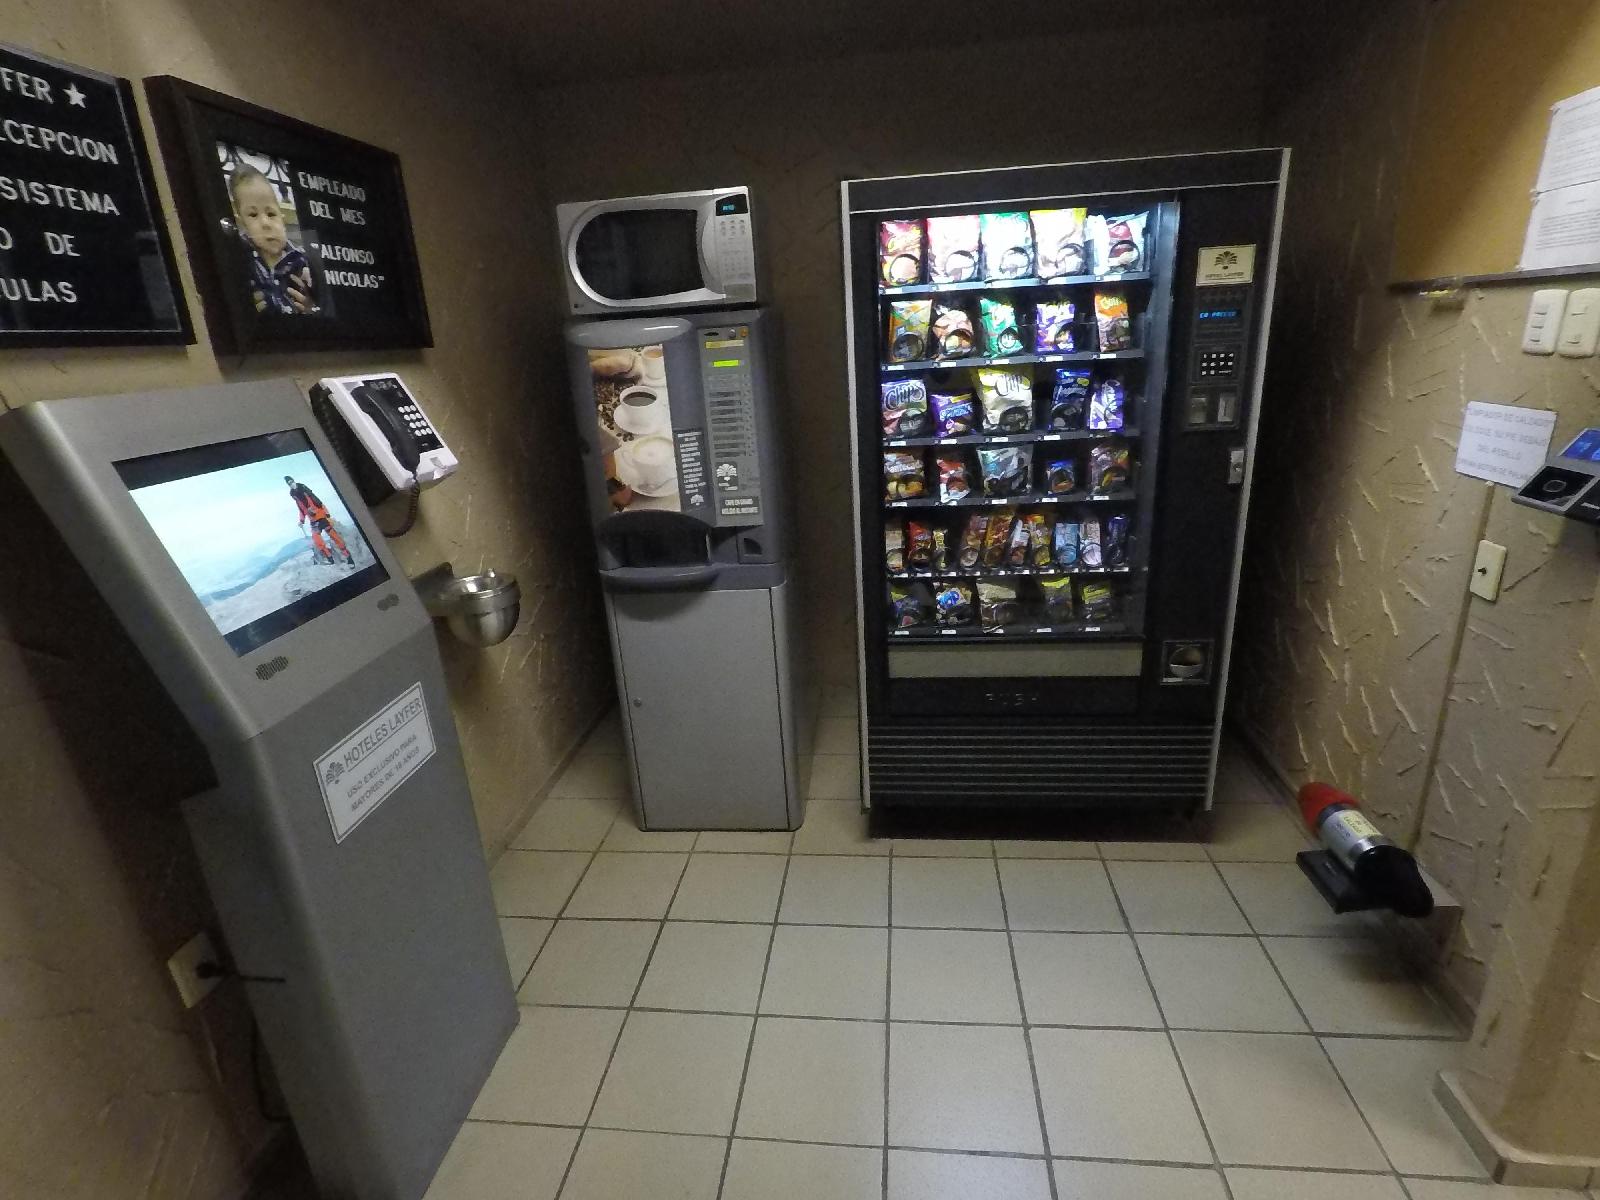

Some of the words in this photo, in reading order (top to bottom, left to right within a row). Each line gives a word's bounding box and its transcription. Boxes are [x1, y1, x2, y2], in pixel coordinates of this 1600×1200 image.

[0, 66, 55, 105] FER
[0, 119, 119, 165] CEPCION
[0, 176, 121, 216] SISTEMA
[298, 171, 366, 202] EMPLEADO
[309, 200, 335, 219] DEL
[340, 207, 366, 226] MES
[43, 231, 81, 257] DE
[343, 723, 389, 769] HOTELES
[388, 697, 423, 732] LAYFER
